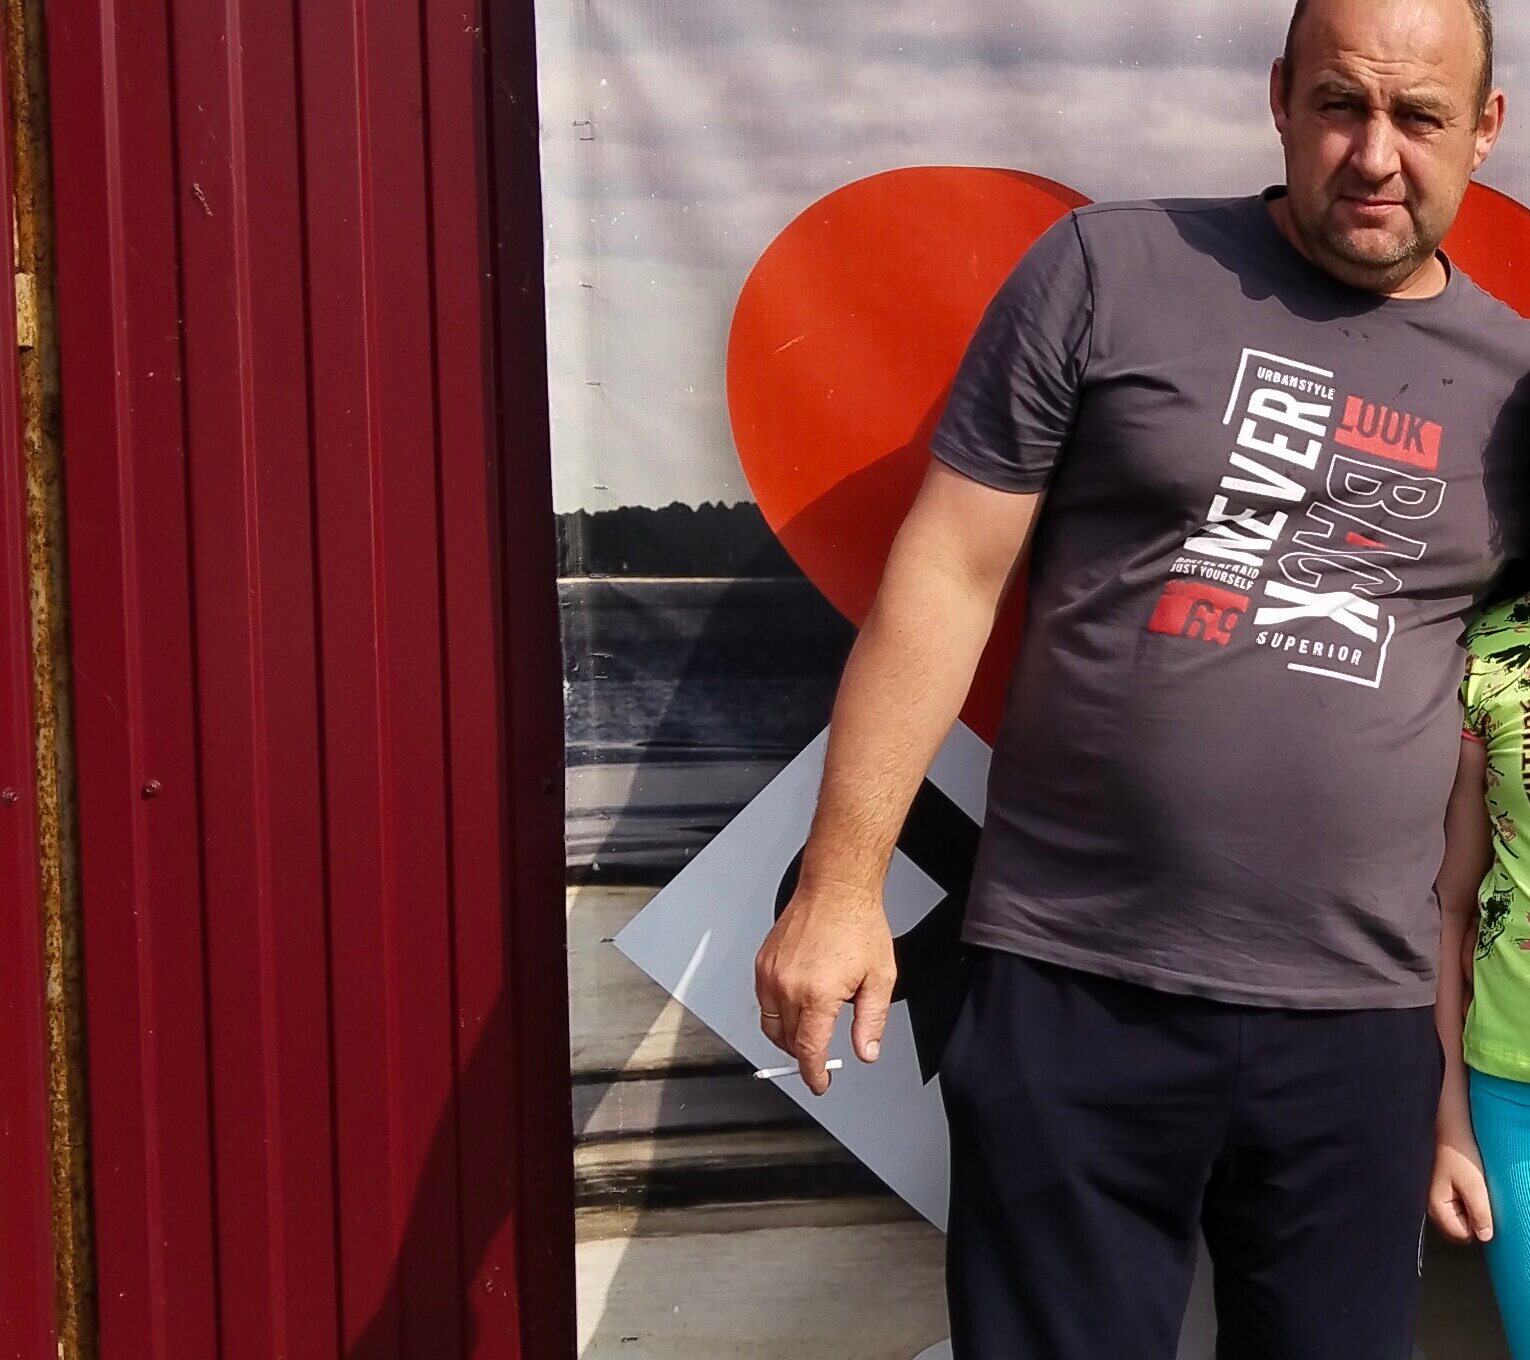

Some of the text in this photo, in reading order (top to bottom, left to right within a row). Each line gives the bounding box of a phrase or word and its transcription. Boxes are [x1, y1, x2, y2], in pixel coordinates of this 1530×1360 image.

[1183, 387, 1332, 567] NEVER
[1200, 566, 1254, 591] YOURSELF
[1253, 454, 1447, 643] BACK
[1256, 631, 1363, 666] SUPERIOR
